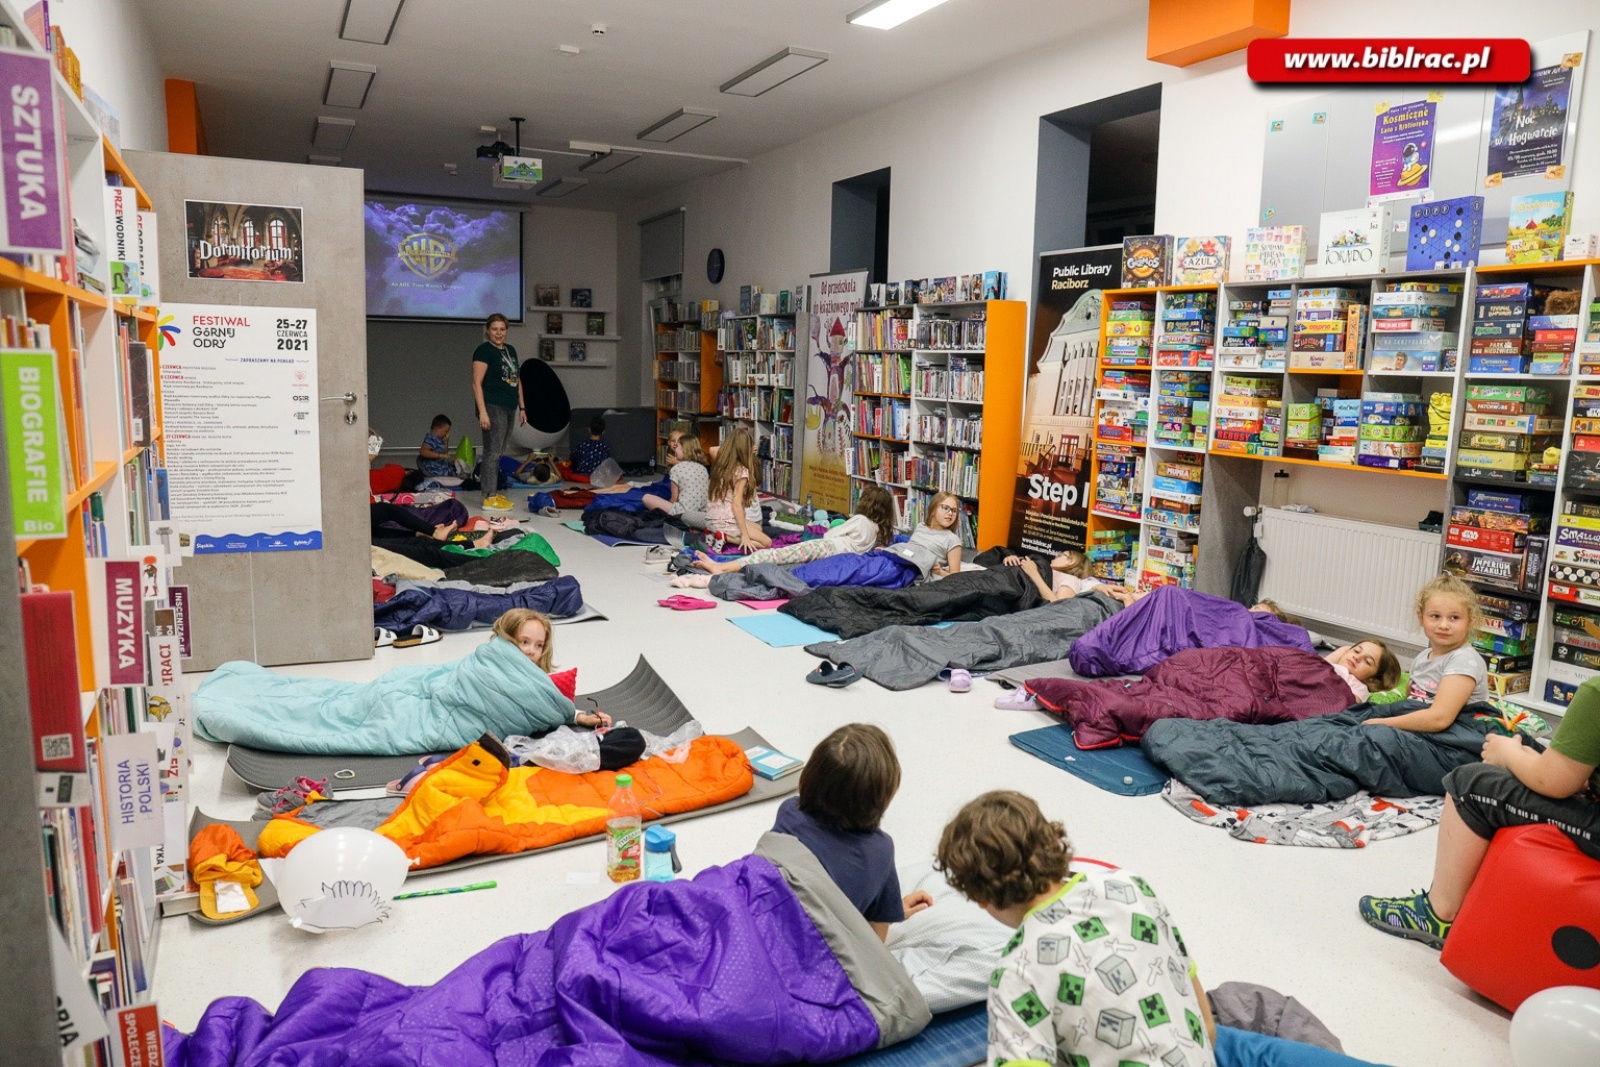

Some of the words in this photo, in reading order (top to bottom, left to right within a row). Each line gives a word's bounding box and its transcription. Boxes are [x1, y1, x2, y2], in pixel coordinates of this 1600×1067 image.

[1382, 108, 1429, 125] Kosmiczne
[1515, 116, 1535, 130] Noc
[1494, 138, 1503, 146] w
[1508, 126, 1558, 146] Hogwarcie
[11, 85, 48, 220] SZTUKA
[113, 189, 126, 261] PRZEWODNIKI
[1053, 264, 1080, 277] Public
[1080, 263, 1113, 276] Library
[1187, 258, 1212, 266] AZUL
[1051, 277, 1089, 290] Raciborz
[192, 315, 250, 327] FESTIWAL
[276, 319, 307, 330] 25-27
[276, 329, 308, 338] CZERWCA
[193, 338, 227, 349] ODRY
[277, 338, 308, 351] 2021
[18, 366, 48, 503] BIOGRAFIE
[1217, 430, 1250, 442] REBUSY
[1028, 473, 1078, 511] Step
[1472, 556, 1511, 574] IMPERIUM
[1473, 566, 1508, 576] ATAKUJE
[115, 577, 135, 669] MUZYKA
[159, 644, 173, 686] IRACI
[117, 759, 134, 825] HISTORIA
[136, 763, 152, 814] POLSKI
